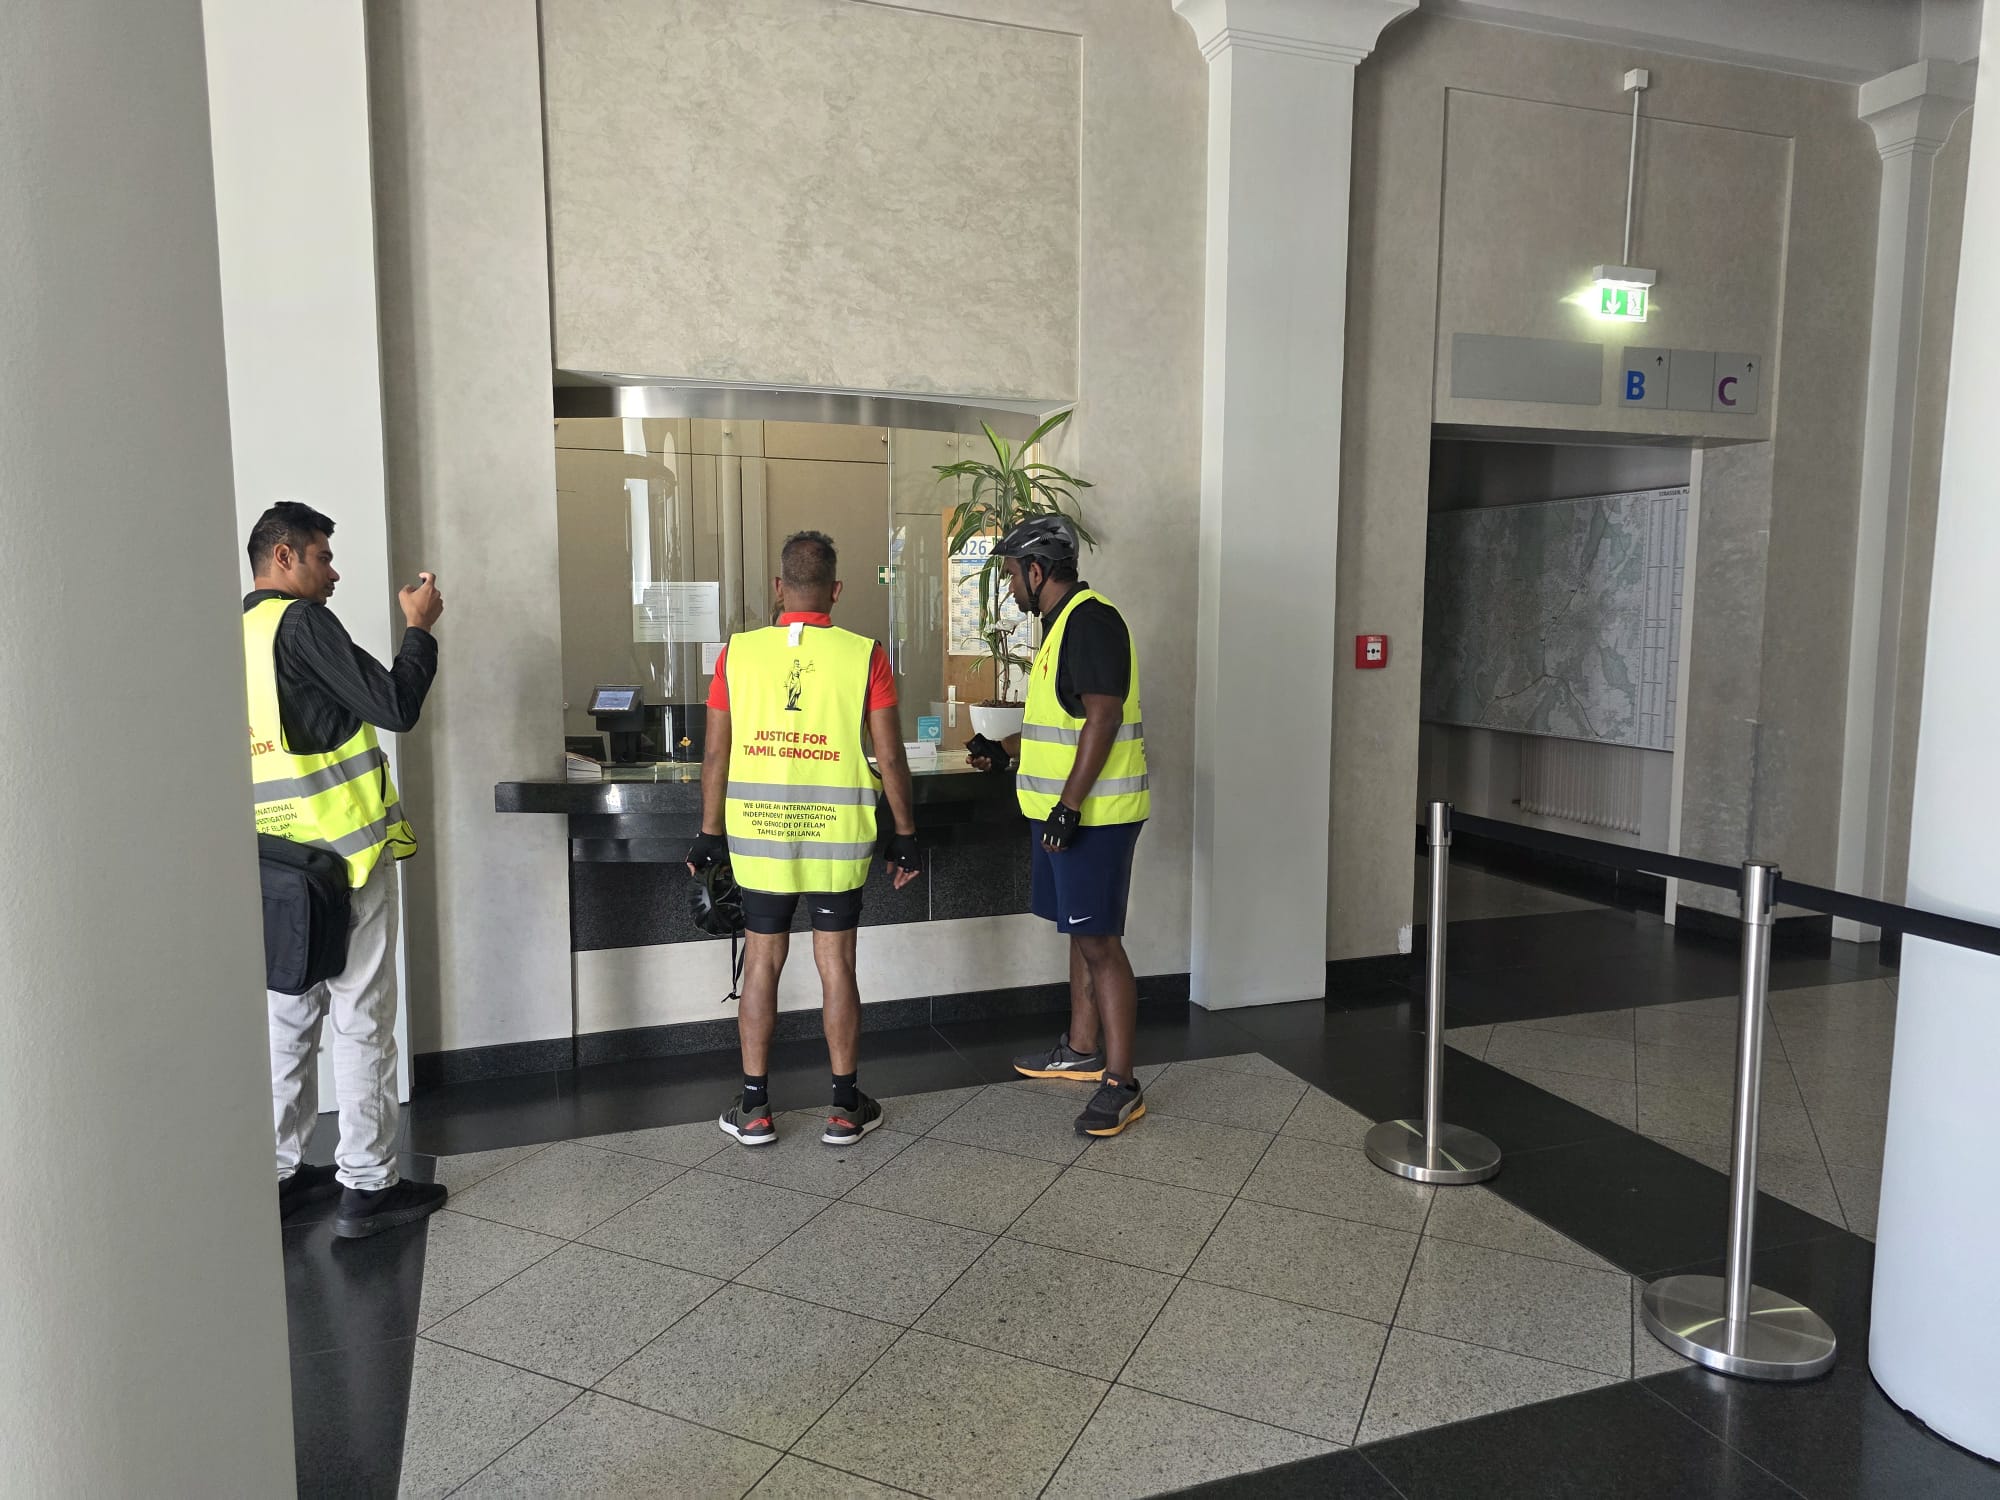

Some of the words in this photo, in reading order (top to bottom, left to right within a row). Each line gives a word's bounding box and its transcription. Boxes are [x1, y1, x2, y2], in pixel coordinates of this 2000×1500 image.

[1626, 370, 1645, 400] B
[1718, 376, 1737, 406] C
[954, 540, 987, 555] 026
[754, 731, 800, 743] JUSTICE
[803, 733, 827, 745] FOR
[251, 740, 275, 756] IDE
[743, 745, 776, 757] TAMIL
[779, 747, 841, 762] GENOCIDE
[755, 802, 772, 810] URGE
[781, 804, 836, 812] INTERNATIONAL
[742, 811, 783, 819] INDEPENDENT
[785, 813, 837, 821] INVESTIGATION
[764, 820, 792, 829] GENOCIDE
[757, 828, 777, 836] TAMILS
[797, 830, 821, 838] LANKA
